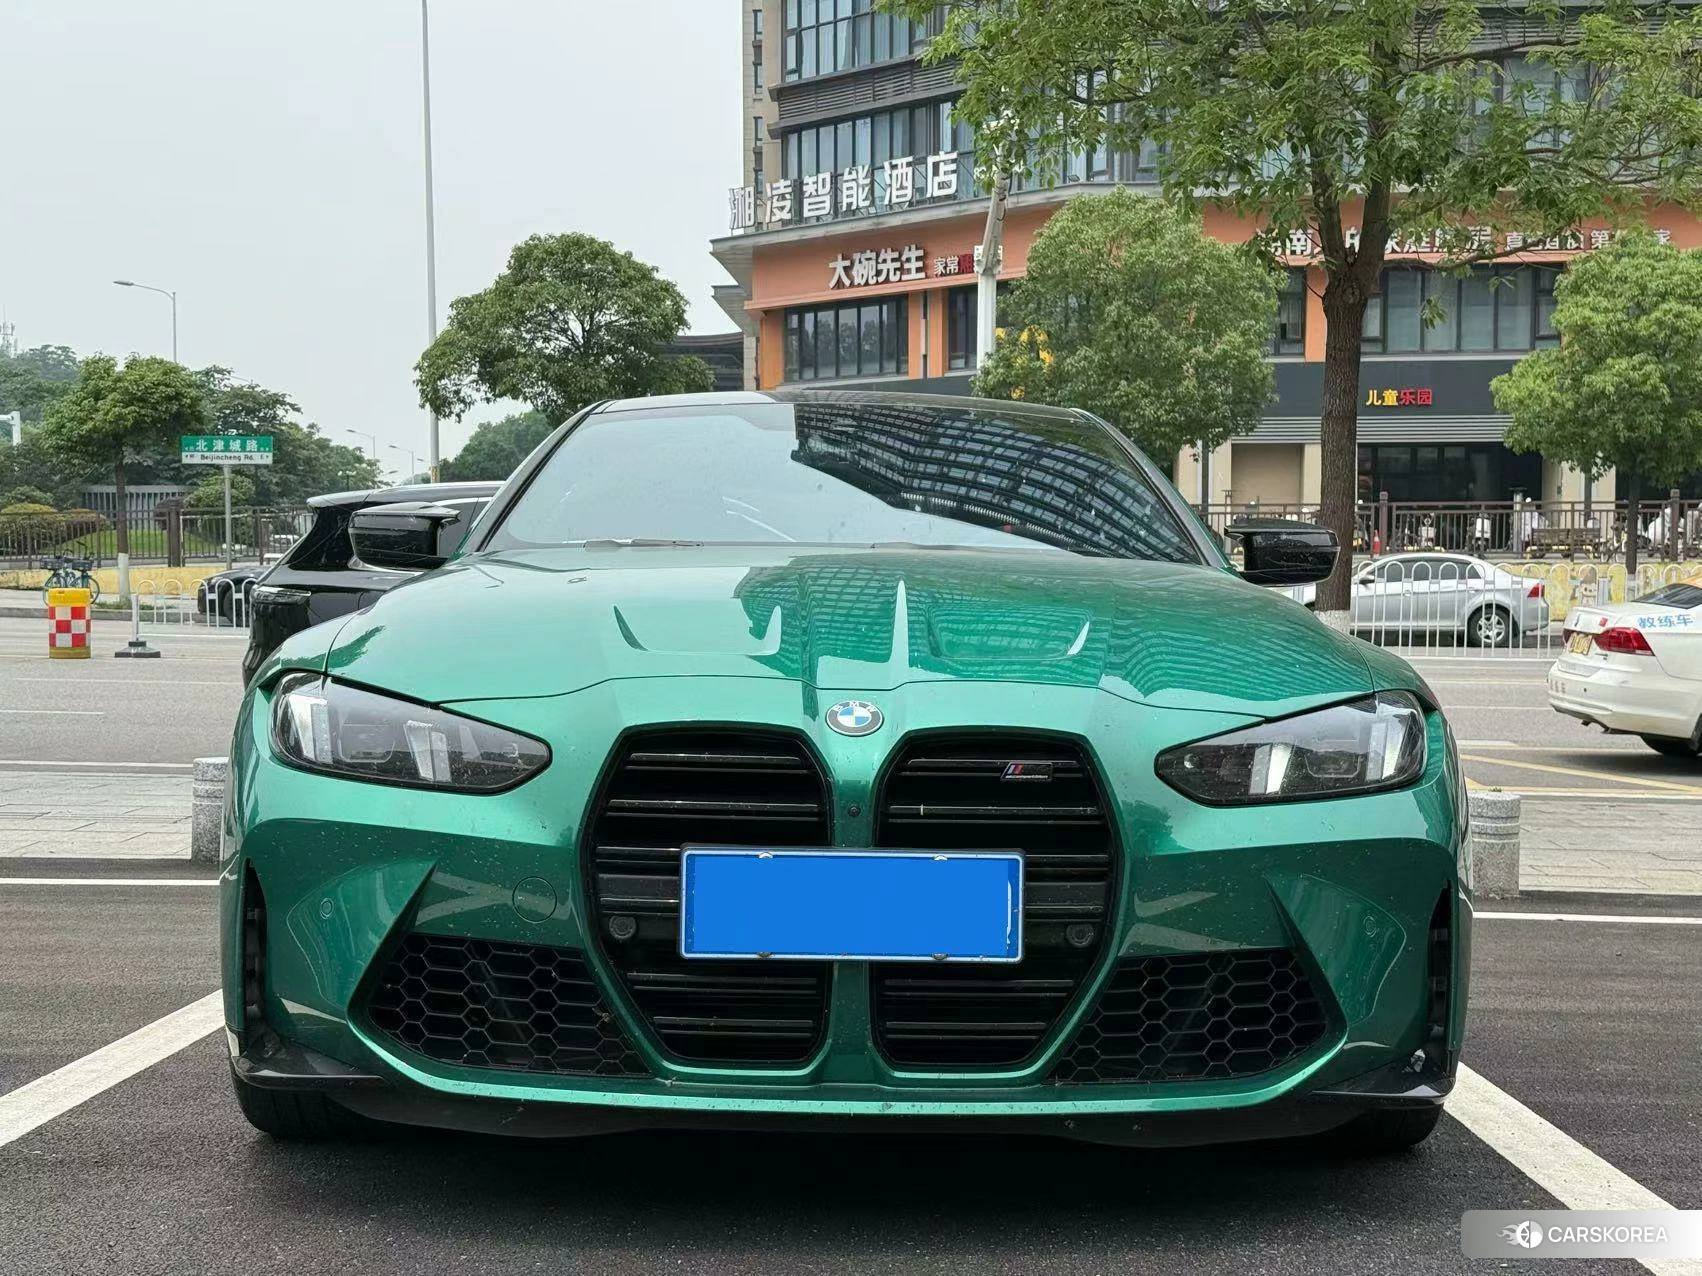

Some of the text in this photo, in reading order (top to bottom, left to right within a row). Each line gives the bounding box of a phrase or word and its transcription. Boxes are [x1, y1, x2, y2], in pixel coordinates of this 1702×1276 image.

[829, 244, 926, 289] 大碗先生
[1365, 389, 1433, 406] 儿童乐园
[196, 439, 258, 451] 北津城路
[1637, 613, 1694, 629] 教练车
